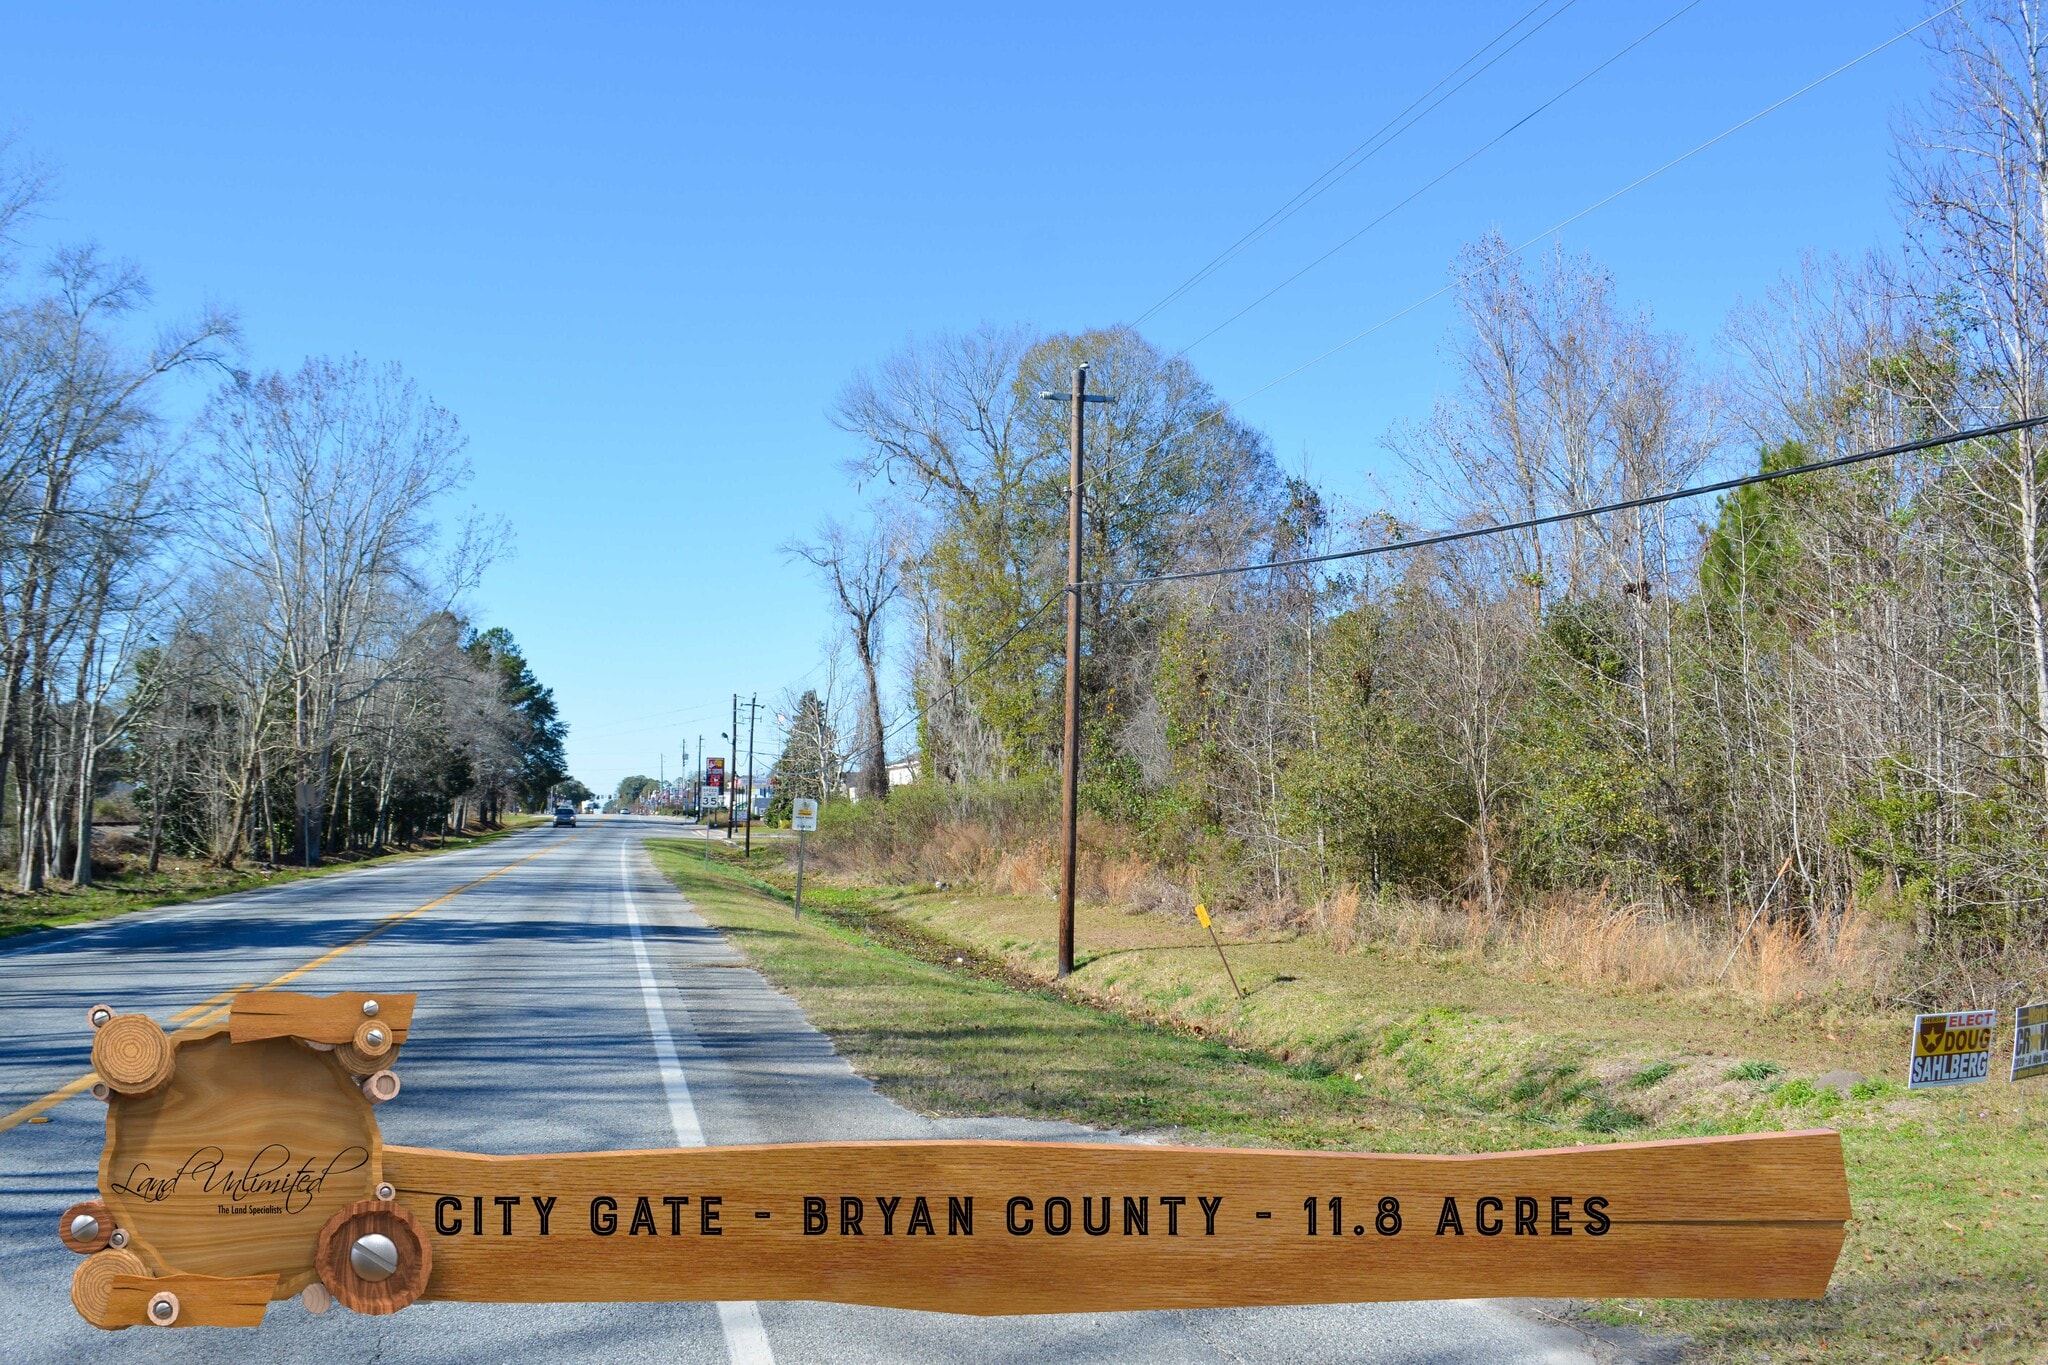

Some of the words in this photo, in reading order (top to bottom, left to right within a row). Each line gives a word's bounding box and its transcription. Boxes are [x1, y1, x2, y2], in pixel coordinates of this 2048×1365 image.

[702, 797, 717, 806] 35
[1949, 1013, 1993, 1028] ELECT
[1945, 1029, 1991, 1052] DOUG
[1913, 1051, 1988, 1083] SAHLBERG
